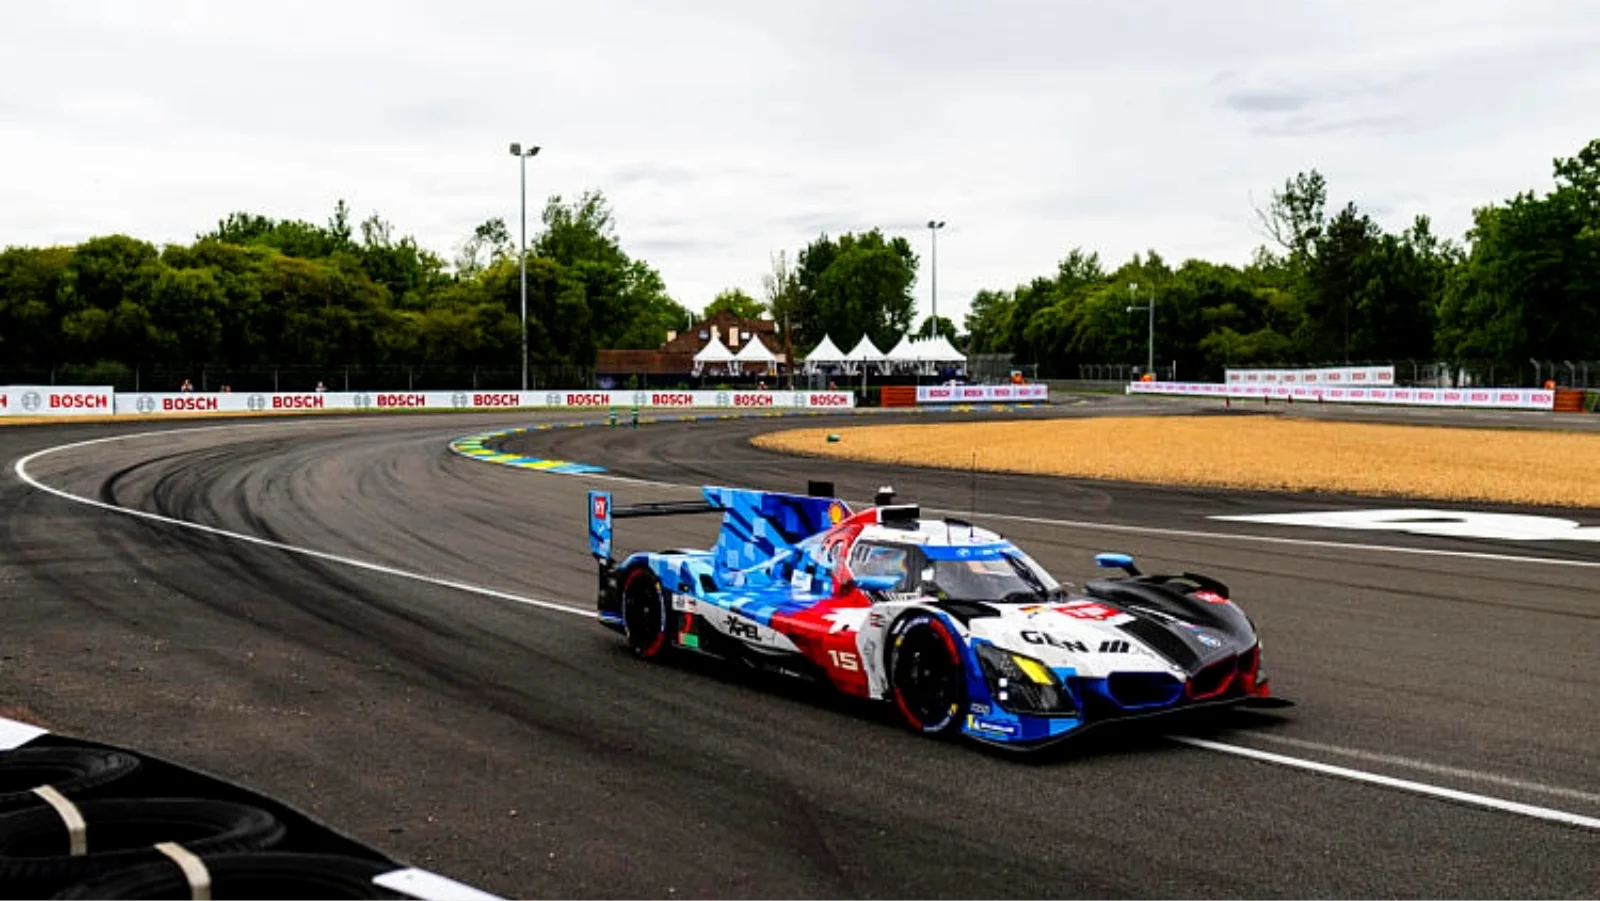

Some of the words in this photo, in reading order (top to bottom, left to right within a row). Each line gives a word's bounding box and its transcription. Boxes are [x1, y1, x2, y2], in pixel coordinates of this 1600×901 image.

[49, 393, 107, 409] BOSCH
[162, 396, 218, 411] BOSCH
[272, 395, 324, 409] BOSCH
[376, 394, 426, 408] BOSCH
[473, 394, 520, 408] BOSCH
[566, 394, 611, 407] BOSCH
[651, 394, 692, 407] BOSCH
[733, 394, 773, 407] BOSCH
[810, 394, 847, 406] BOSCH
[827, 649, 859, 672] 15
